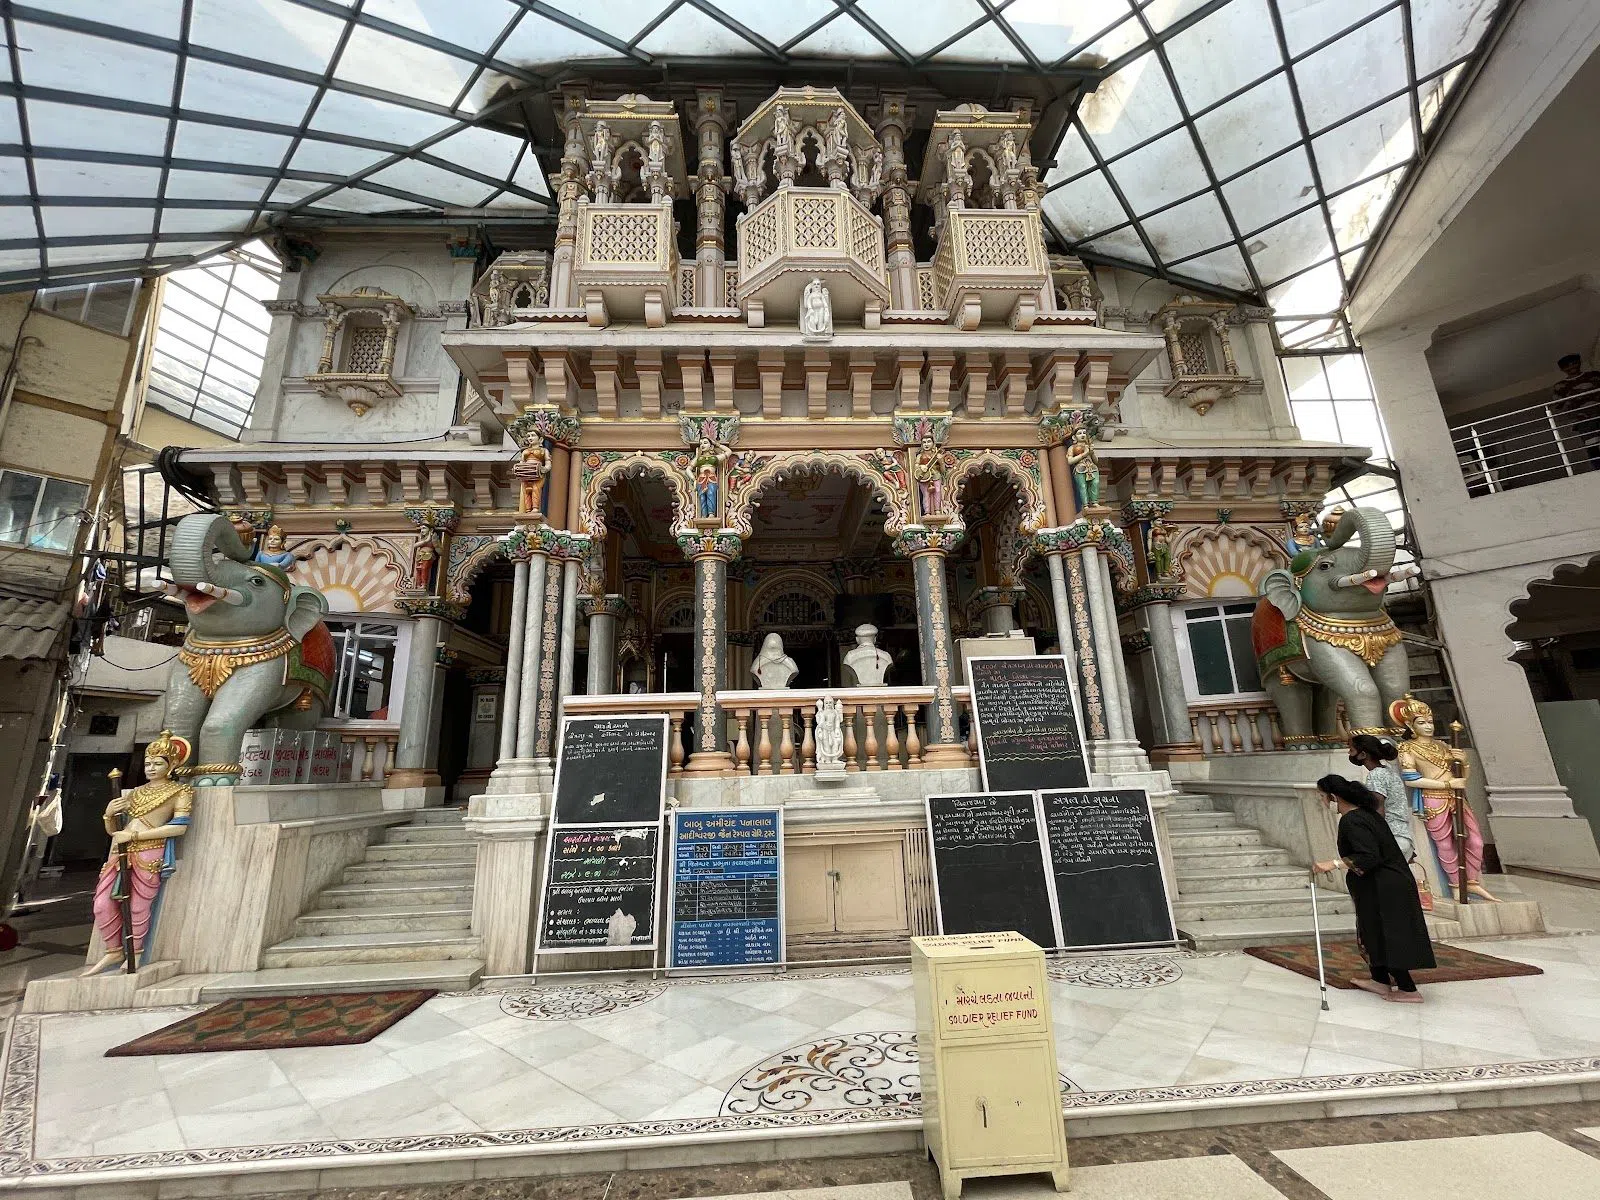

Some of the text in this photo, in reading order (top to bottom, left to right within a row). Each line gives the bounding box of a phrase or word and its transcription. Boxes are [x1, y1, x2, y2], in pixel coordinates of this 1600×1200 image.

[684, 818, 772, 831] બાબુ અમીચંદ પનાલાલ
[718, 829, 732, 839] જૈન
[948, 1008, 1038, 1025] SOLDIER RELIEF FUND
